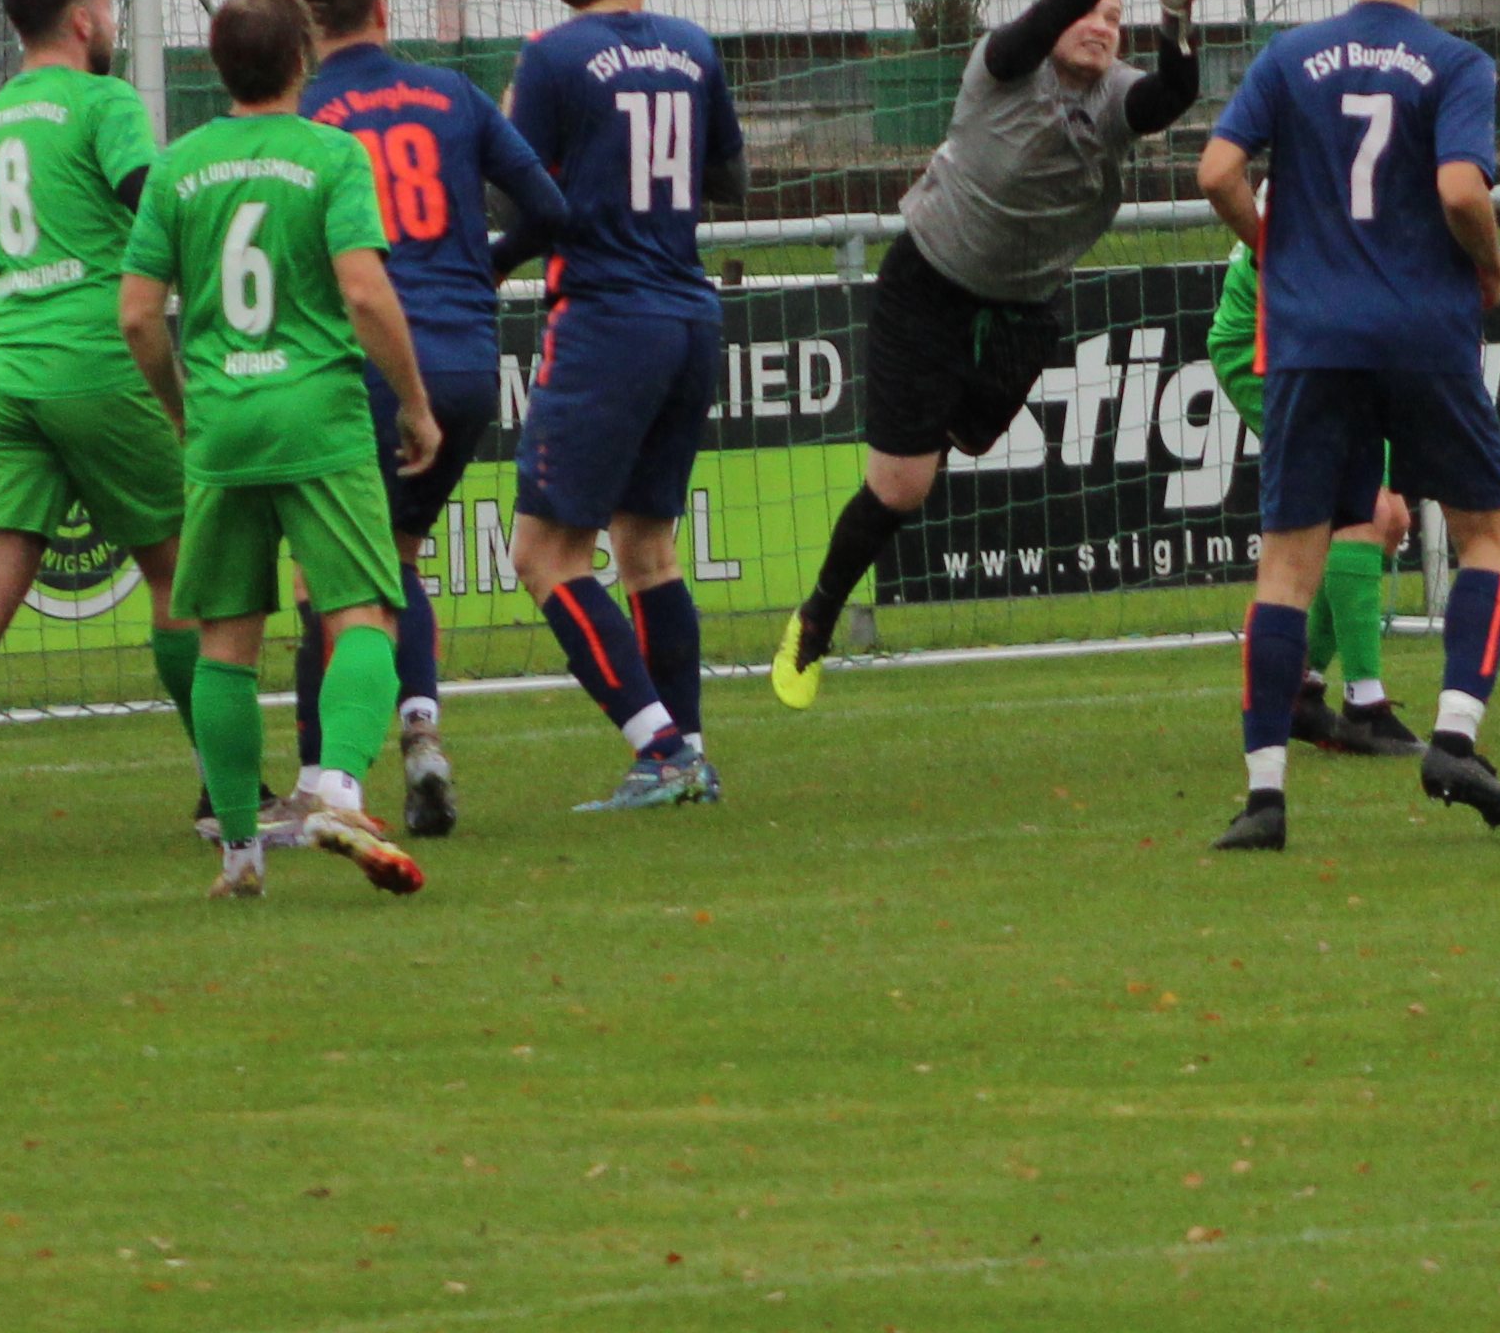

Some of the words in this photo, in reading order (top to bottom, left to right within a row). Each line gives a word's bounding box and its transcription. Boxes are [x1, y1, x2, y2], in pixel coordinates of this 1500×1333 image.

[586, 46, 622, 83] TSV
[1303, 45, 1342, 81] TSV
[1347, 41, 1434, 85] Burgheim
[175, 173, 198, 200] SV
[351, 122, 448, 243] 18
[615, 91, 692, 212] 14
[1341, 93, 1393, 220] 7
[221, 202, 274, 336] 6
